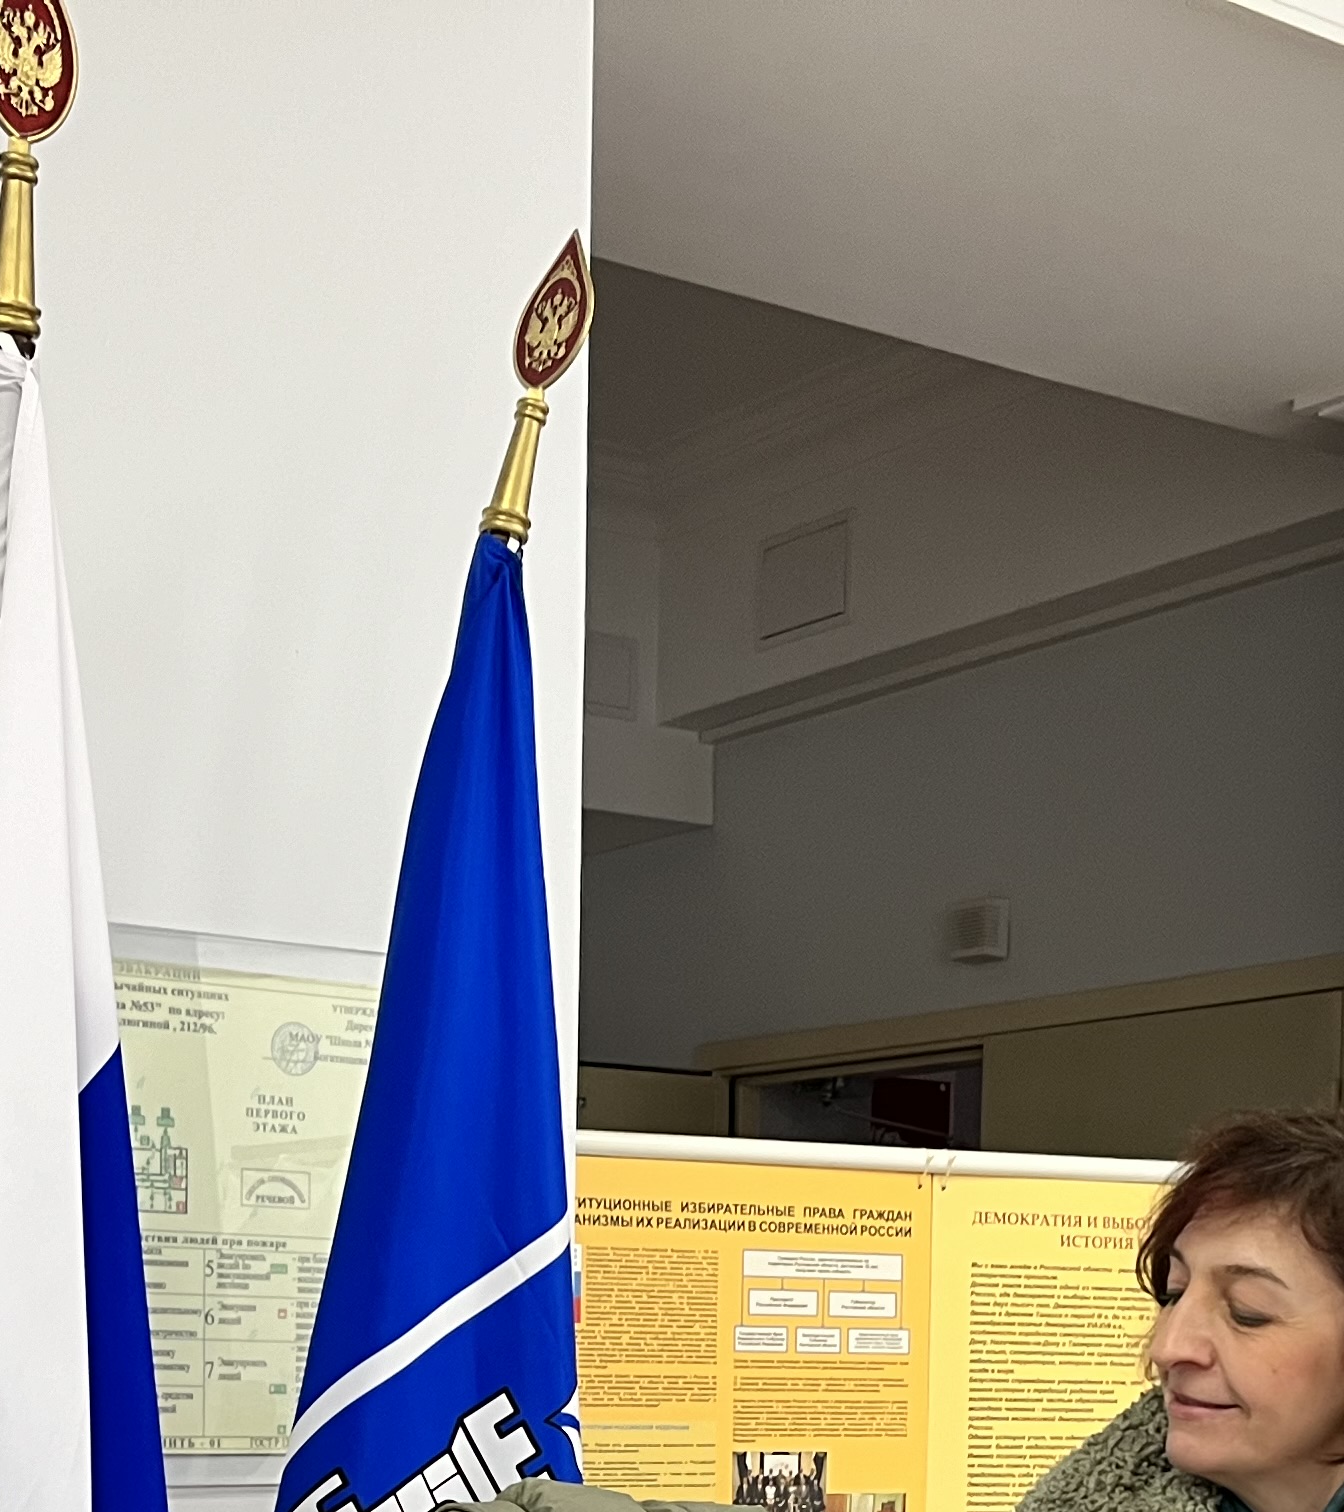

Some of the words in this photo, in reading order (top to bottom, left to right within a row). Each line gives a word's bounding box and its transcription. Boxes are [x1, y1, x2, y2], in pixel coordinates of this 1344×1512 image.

[256, 1094, 294, 1107] ПЛАН
[245, 1107, 306, 1122] ПЕРВОГО
[252, 1122, 298, 1136] ЭТАЖА
[575, 1196, 672, 1213] ИТУЦИОННЫЕ
[680, 1201, 796, 1218] ИЗБИРАТЕЛЬНЫЕ
[803, 1206, 845, 1220] ПРАВА
[853, 1208, 913, 1223] ГРАЖДАН
[636, 1215, 654, 1229] ИХ
[656, 1216, 746, 1233] РЕАЛИЗАЦИИ
[749, 1220, 757, 1232] В
[759, 1219, 858, 1237] СОВРЕМЕННОЙ
[861, 1224, 913, 1238] РОССИИ
[971, 1211, 1082, 1228] ДЕМОКРАТИЯ
[1087, 1216, 1098, 1229] И
[1059, 1234, 1134, 1249] ИСТОРИЯ
[205, 1259, 215, 1278] 5
[204, 1307, 215, 1326] 6
[204, 1361, 215, 1379] 7
